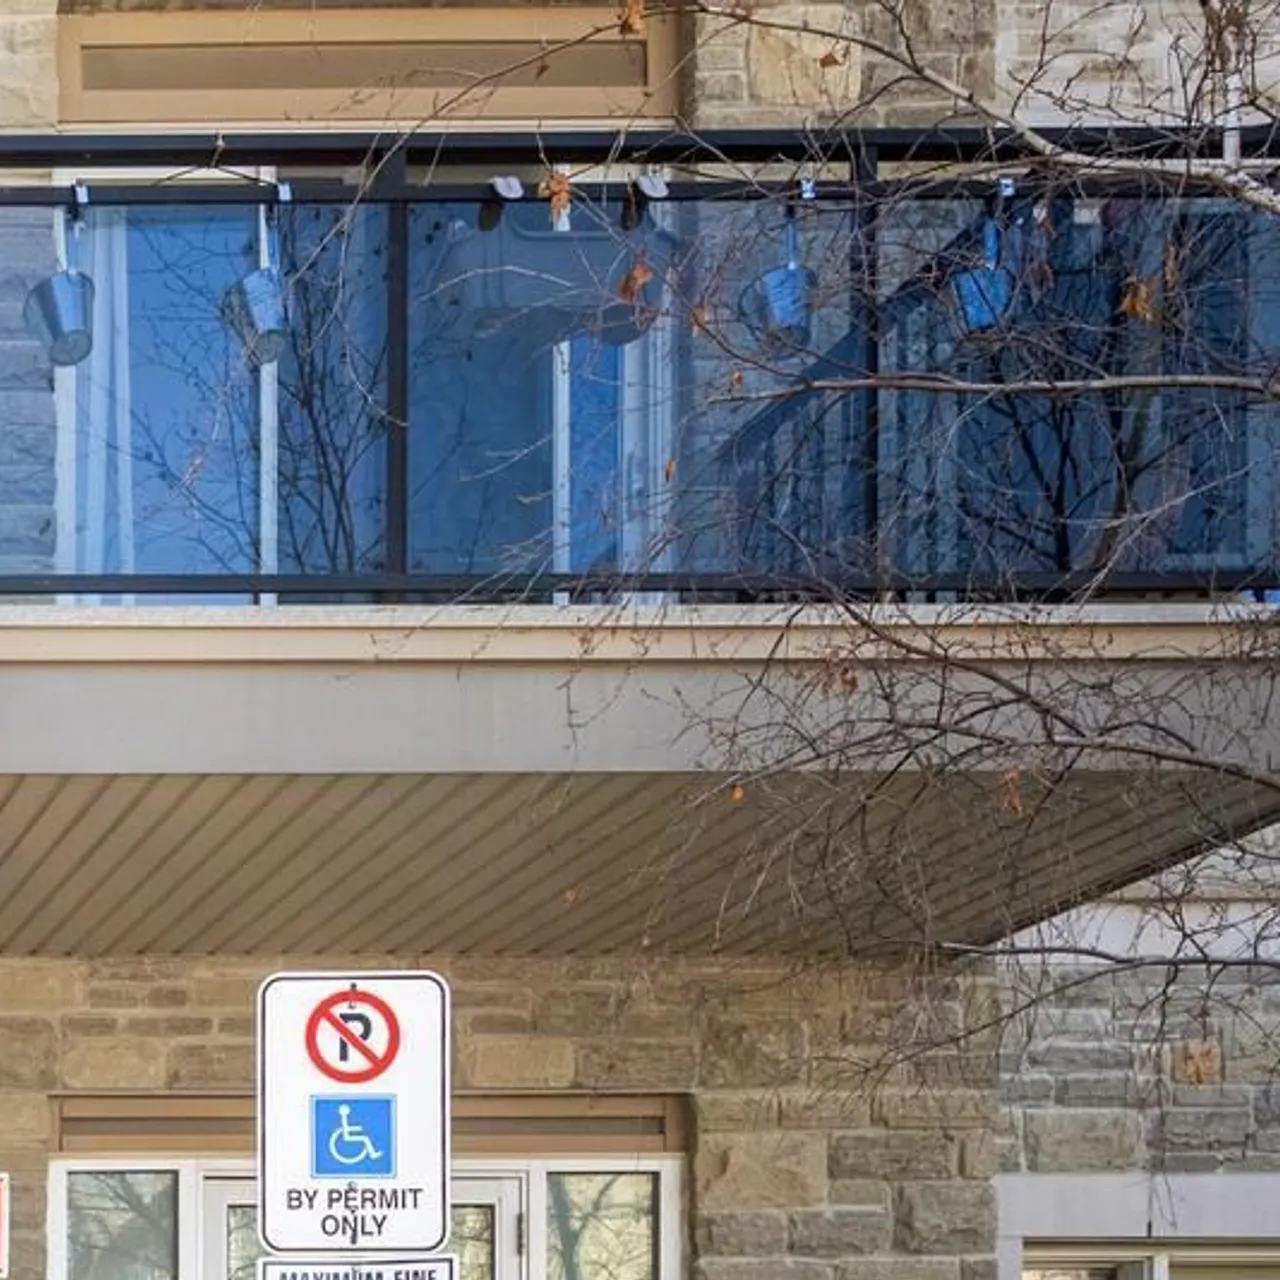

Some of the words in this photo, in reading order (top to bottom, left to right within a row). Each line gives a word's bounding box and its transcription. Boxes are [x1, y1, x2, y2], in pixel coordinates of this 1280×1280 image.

[286, 1188, 319, 1210] BY
[327, 1187, 424, 1210] PERMIT
[321, 1214, 388, 1237] ONLY
